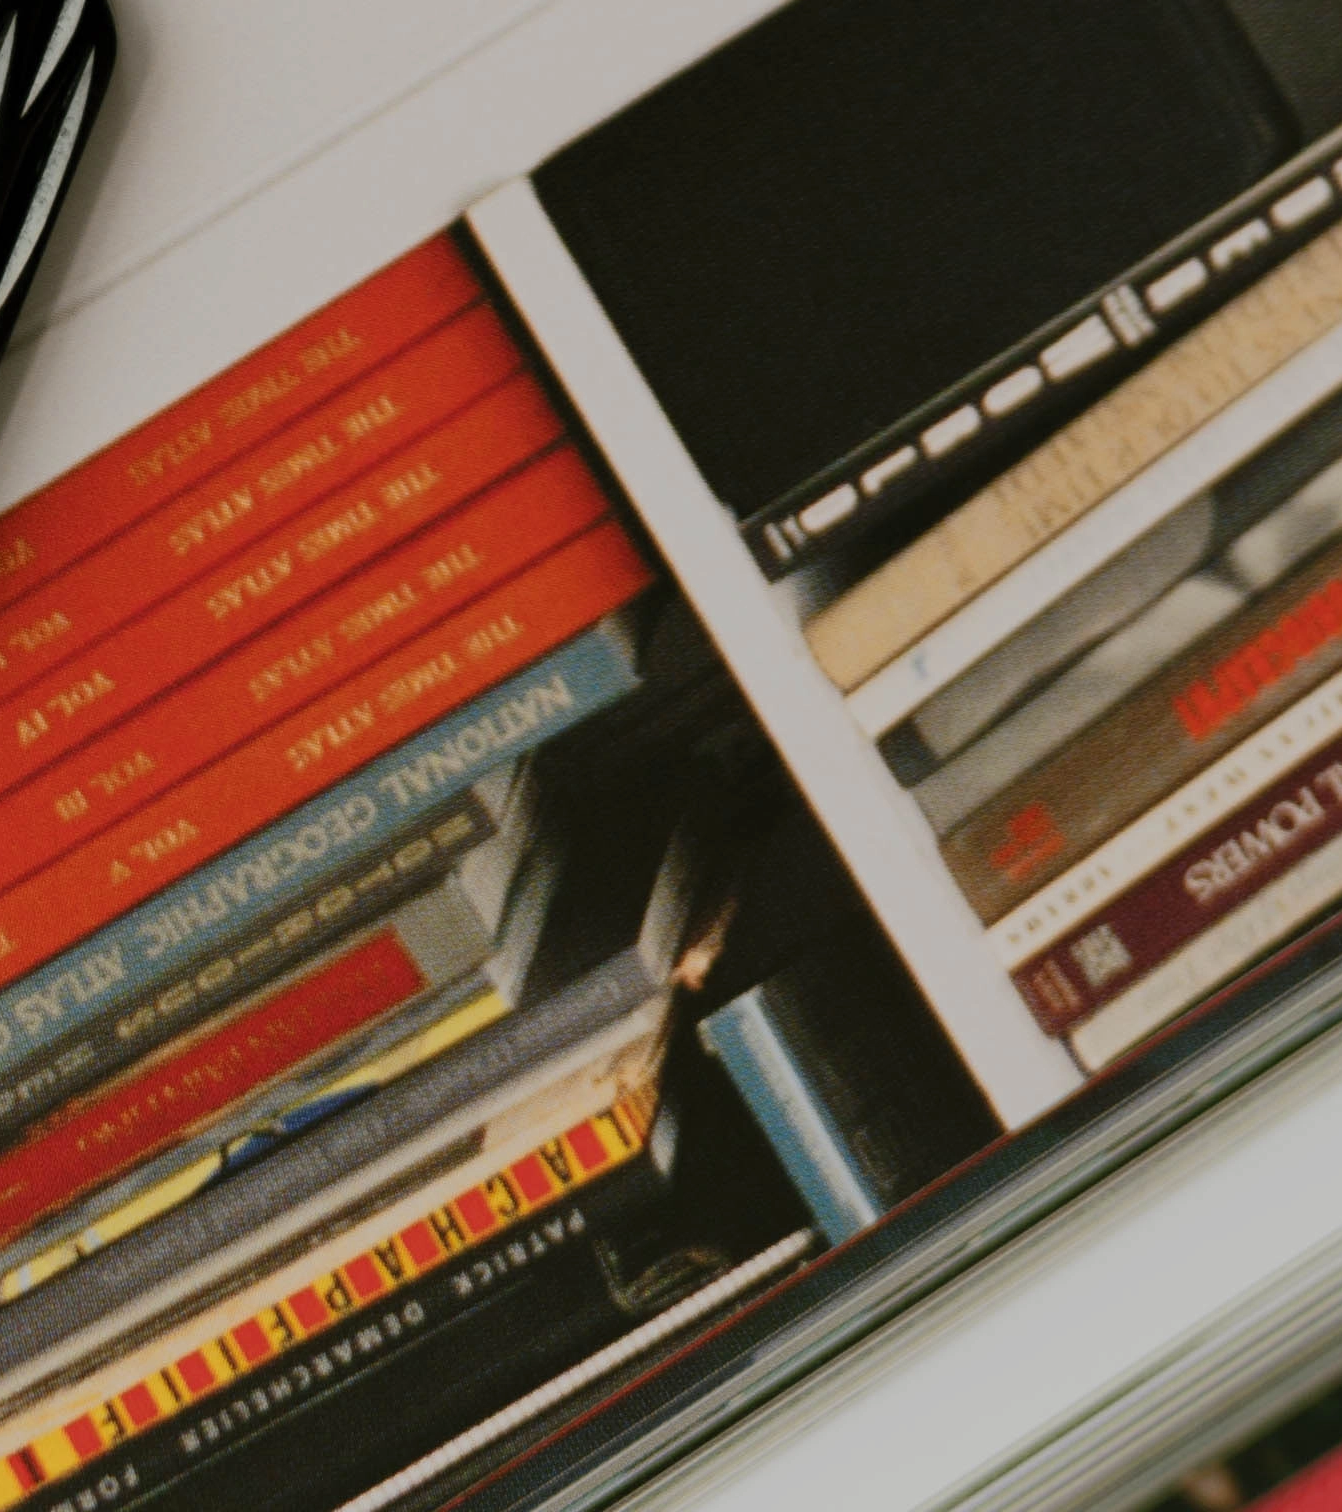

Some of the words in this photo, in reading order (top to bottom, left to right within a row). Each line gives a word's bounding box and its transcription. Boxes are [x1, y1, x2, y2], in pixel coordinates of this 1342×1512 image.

[342, 393, 398, 440] THE
[256, 431, 339, 496] TIMES
[380, 461, 437, 508] THE
[165, 485, 257, 555] ATLAS
[295, 497, 379, 562] TIMES
[204, 551, 296, 619] ATLAS
[419, 542, 477, 592] THE
[337, 581, 416, 643] TIMES
[461, 612, 520, 661] THE
[244, 631, 338, 702] ATLAS
[376, 649, 459, 714] TIMES
[10, 709, 48, 746] IV
[283, 700, 379, 771] ATLAS
[378, 675, 573, 810] NATIONAL
[103, 856, 130, 885] V
[133, 790, 380, 959] GEOGRAPHIC
[1176, 787, 1323, 907] POWERS
[14, 944, 128, 1032] ATLAS
[450, 1206, 585, 1297] PATRICK
[175, 1298, 426, 1455] DEMARCHELIER
